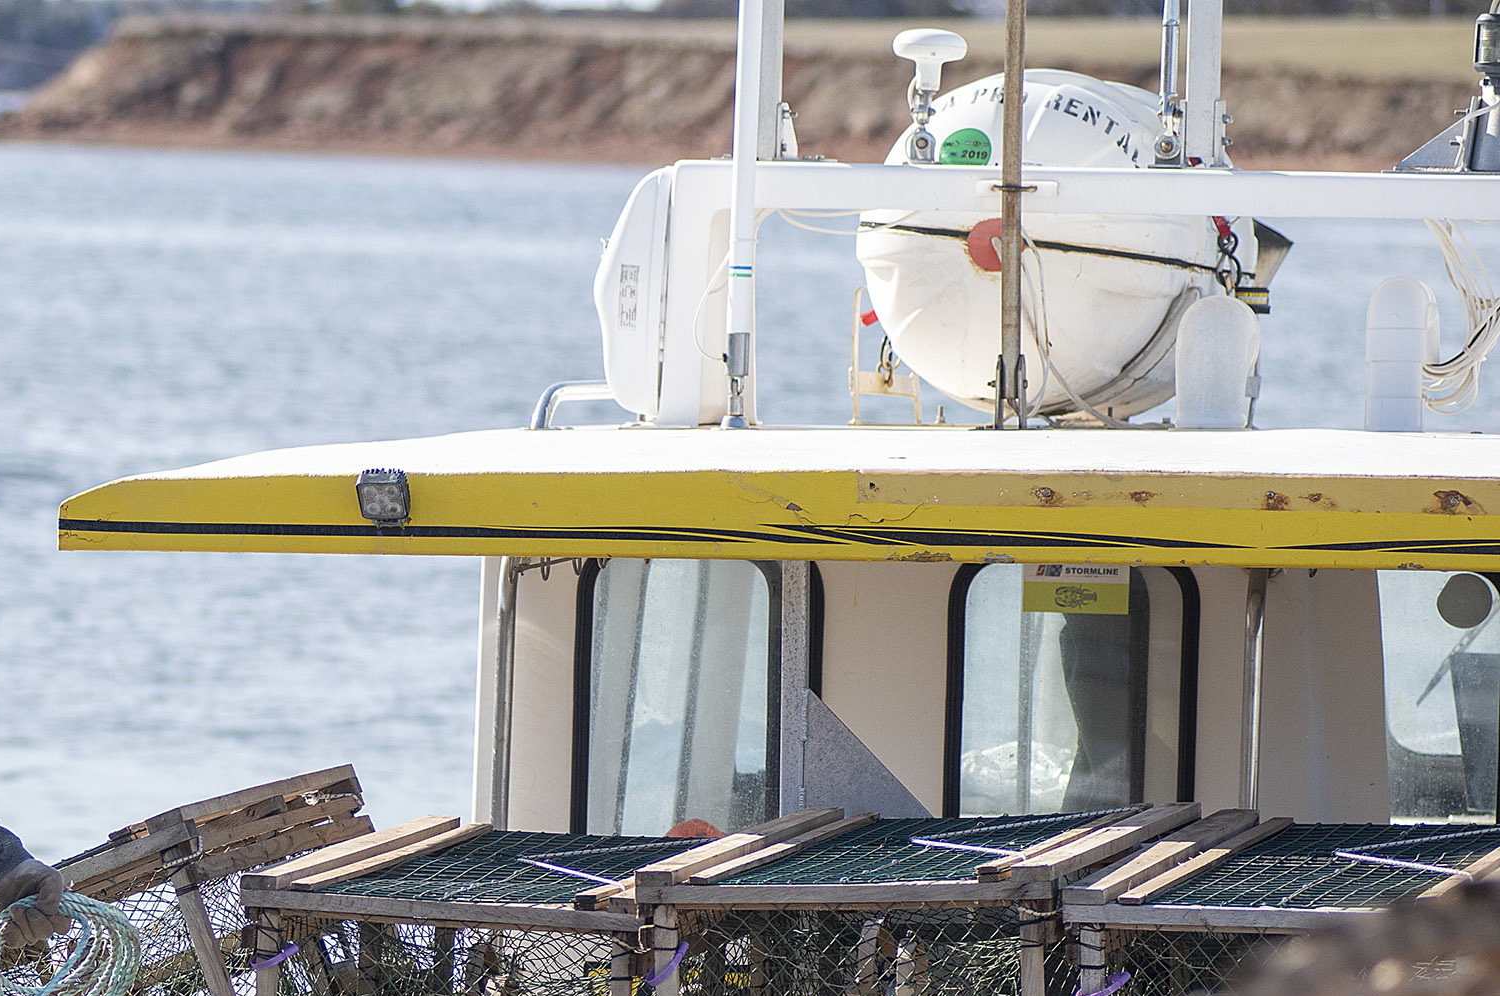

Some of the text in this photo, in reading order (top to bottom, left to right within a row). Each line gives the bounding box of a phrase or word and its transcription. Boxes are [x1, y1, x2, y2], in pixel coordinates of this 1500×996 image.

[1044, 93, 1140, 168] RENTAL
[961, 149, 988, 160] 2019
[1064, 567, 1119, 576] STORMLINE
